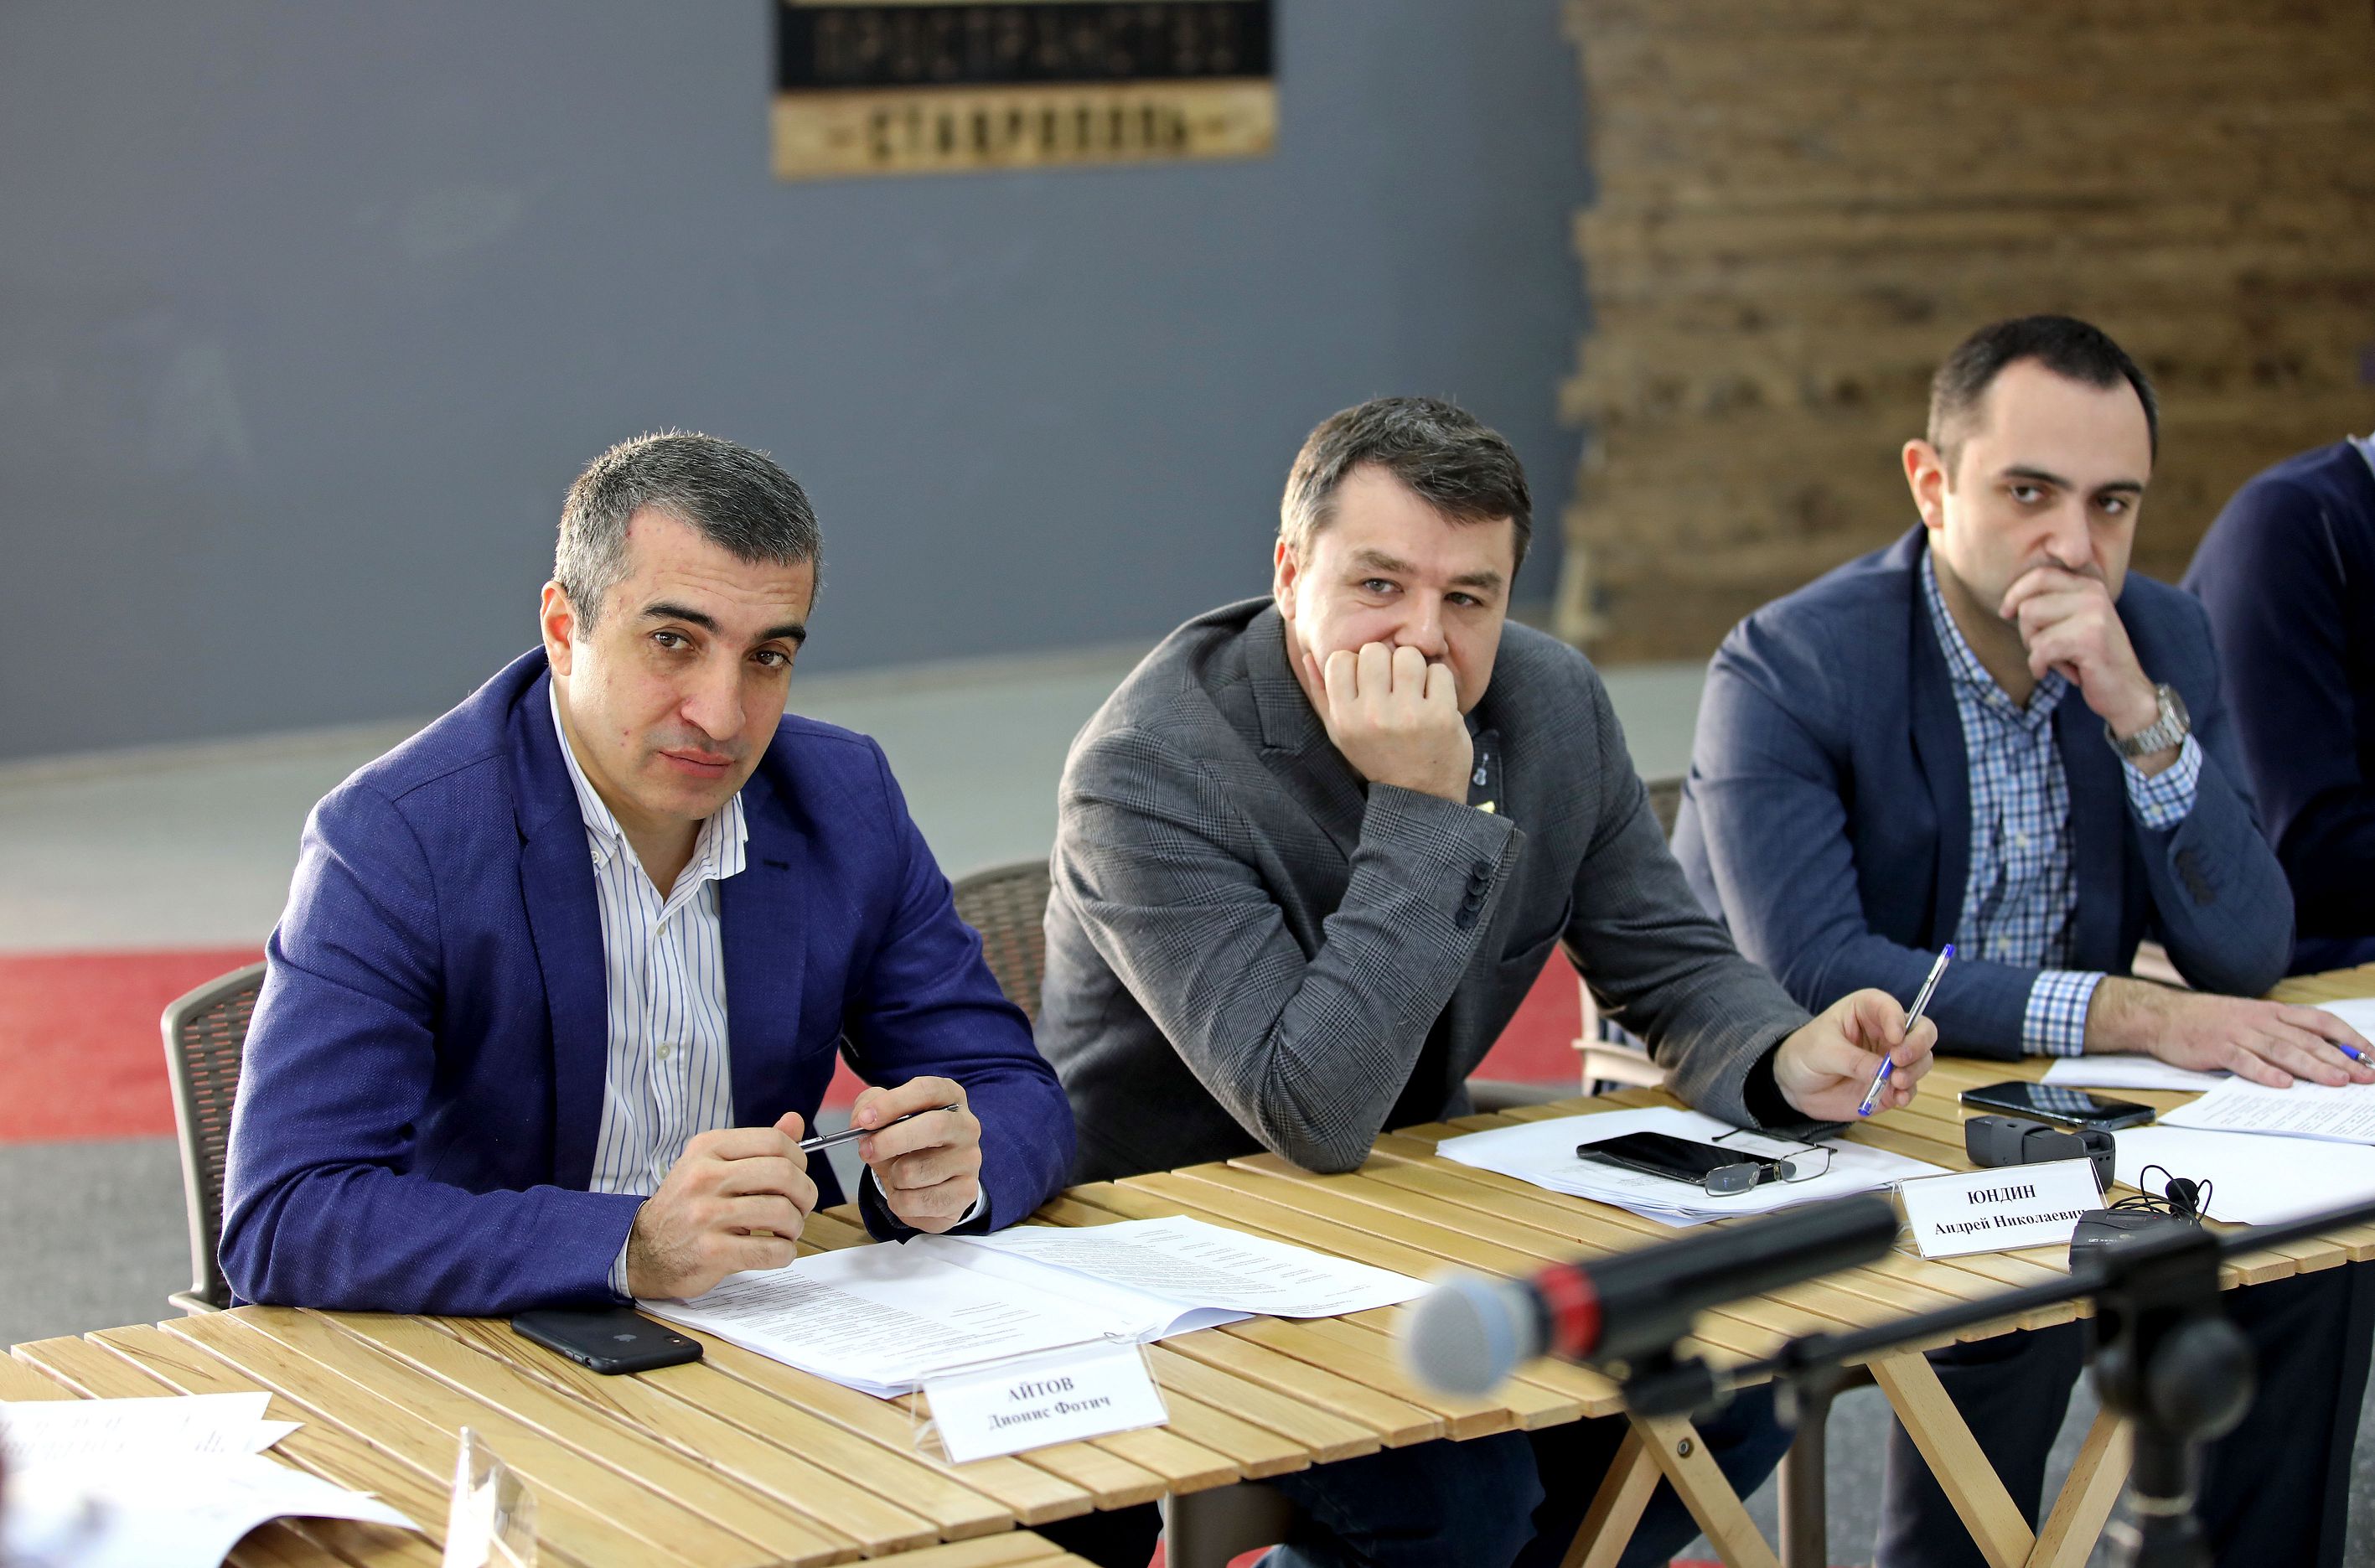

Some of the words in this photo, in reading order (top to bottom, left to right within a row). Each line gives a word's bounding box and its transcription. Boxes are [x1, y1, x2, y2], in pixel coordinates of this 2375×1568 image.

[1966, 1184, 2037, 1205] ЮНДИН
[1935, 1217, 1991, 1235] Андрей
[1008, 1376, 1074, 1402] АЙТОВ
[988, 1407, 1051, 1431] Дионис
[1054, 1395, 1112, 1415] Фотич
